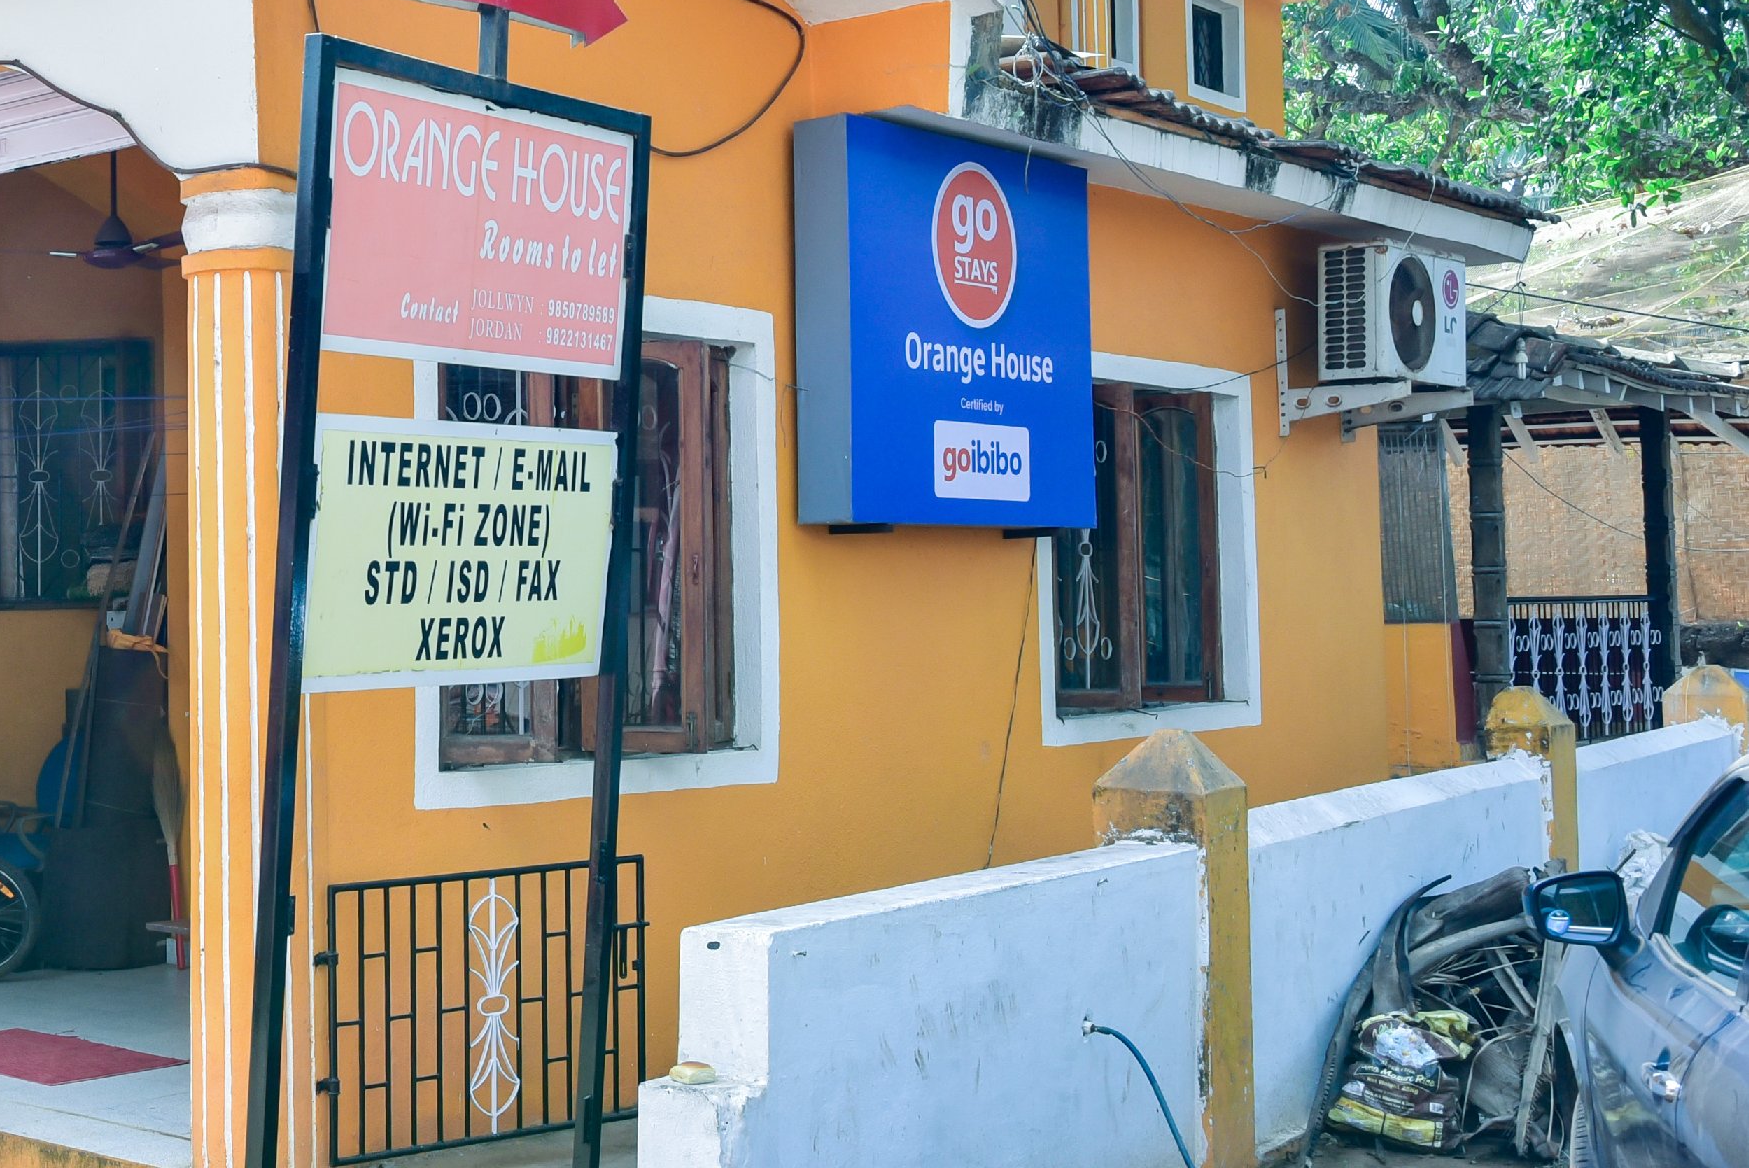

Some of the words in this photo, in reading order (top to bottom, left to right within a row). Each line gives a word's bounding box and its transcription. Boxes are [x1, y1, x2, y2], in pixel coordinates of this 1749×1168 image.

[343, 101, 501, 201] ORANGE
[512, 137, 622, 224] HOUSE
[952, 193, 998, 253] go
[480, 219, 554, 269] Rooms
[562, 235, 583, 273] to
[589, 239, 618, 278] let
[954, 256, 998, 284] STAYS
[400, 292, 460, 324] Contact
[471, 289, 534, 314] JOLLWYN
[548, 299, 615, 324] 9850789589
[468, 318, 523, 341] JORDAN
[546, 327, 614, 351] 9822131467
[905, 332, 986, 383] Orange
[991, 342, 1053, 383] House
[961, 397, 993, 412] Certified
[994, 400, 1004, 415] by
[347, 440, 486, 489] INTERNET
[511, 448, 591, 492] E-MAIL
[943, 440, 1022, 482] goibibo
[388, 501, 465, 558] (Wi-Fi
[474, 504, 550, 558] ZONE)
[364, 560, 418, 605] STD
[446, 560, 489, 603] ISD
[515, 560, 561, 601] FAX
[415, 616, 506, 660] XEROX
